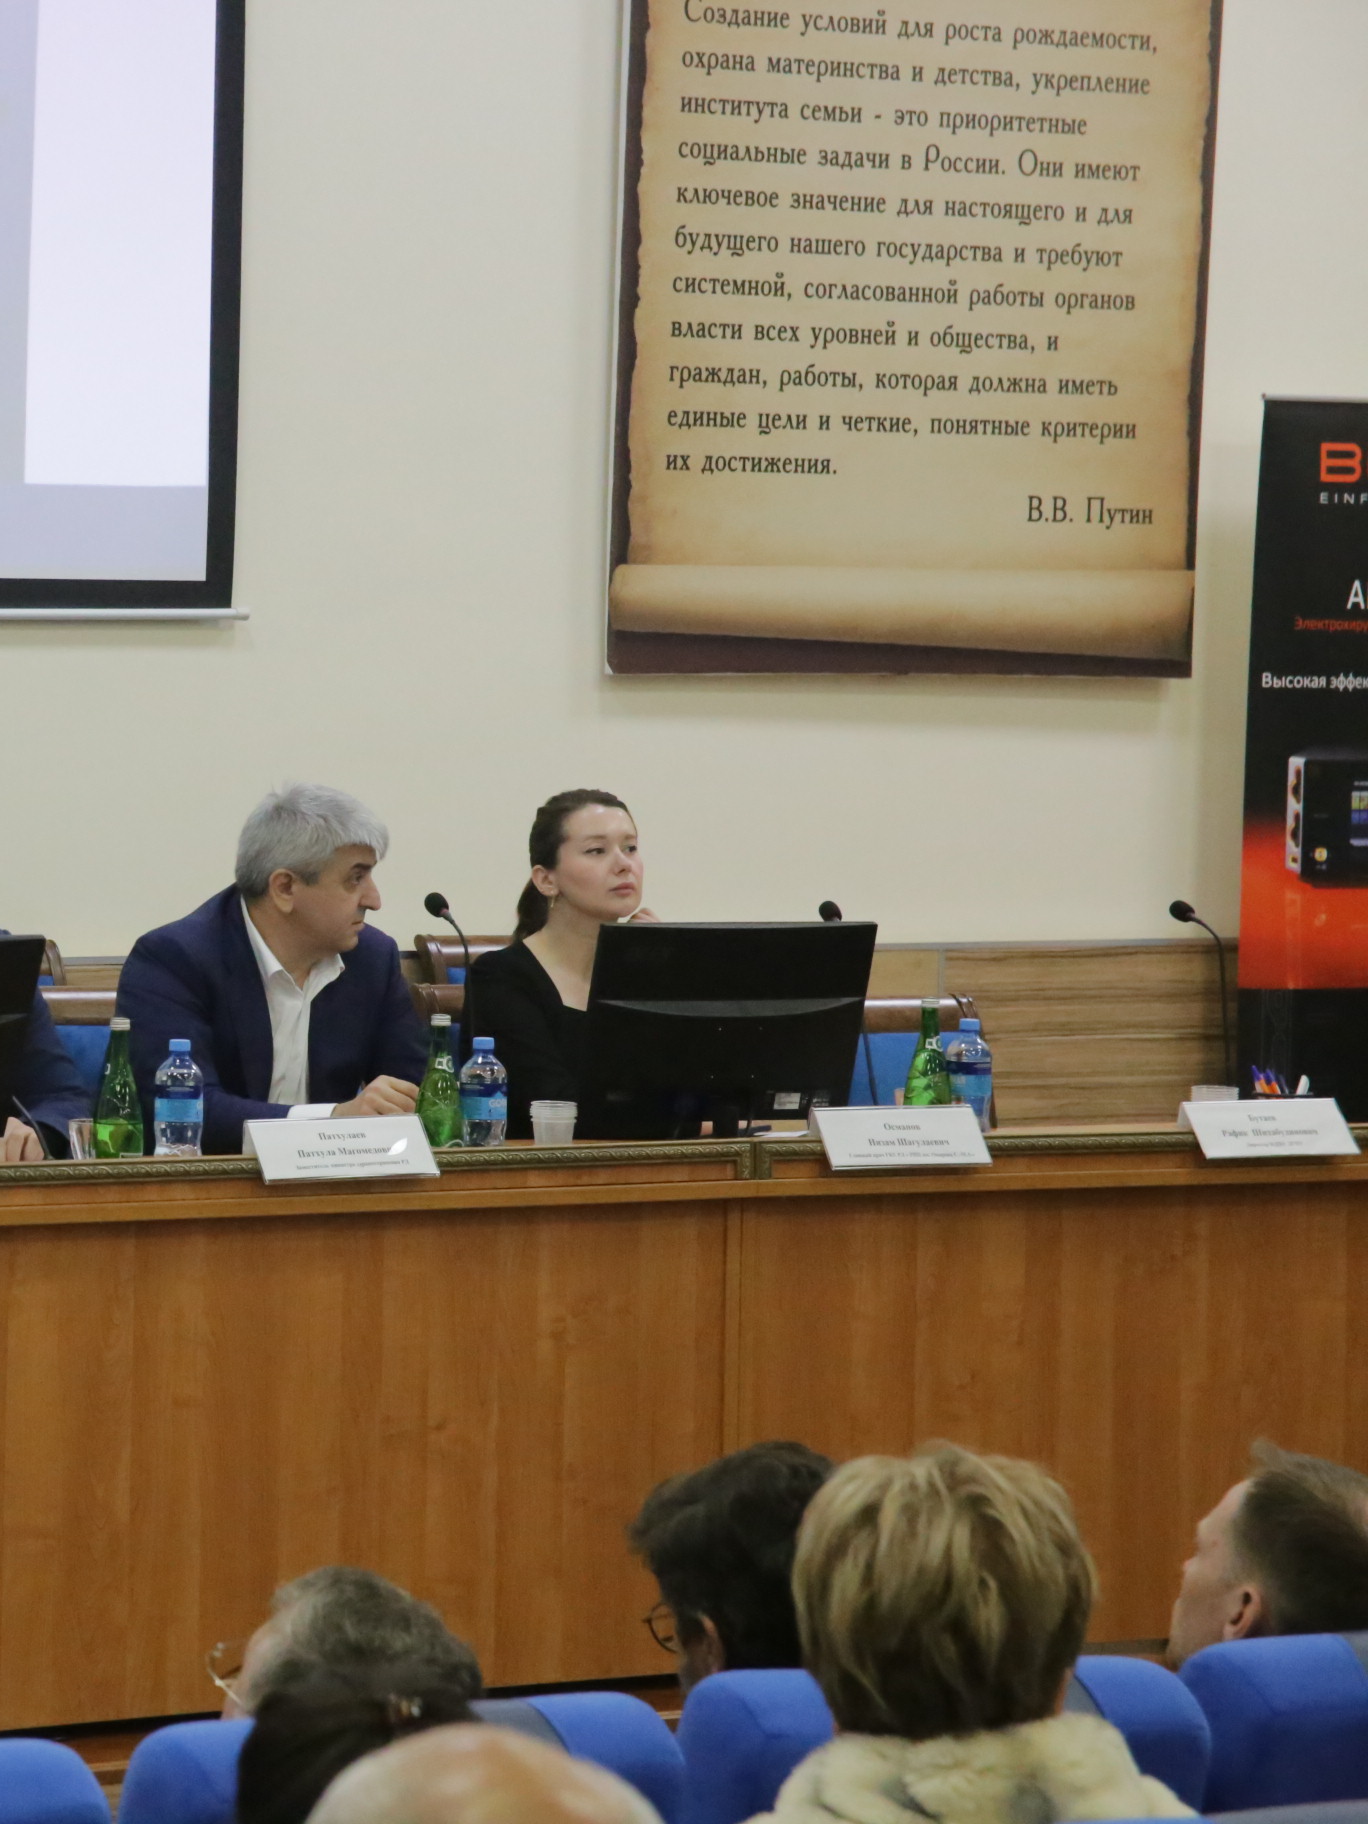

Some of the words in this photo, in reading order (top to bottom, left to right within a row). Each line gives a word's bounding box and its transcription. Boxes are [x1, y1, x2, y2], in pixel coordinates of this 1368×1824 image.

[684, 0, 789, 28] Создание
[800, 10, 886, 36] условий
[897, 20, 934, 40] для
[945, 23, 1002, 46] роста
[1013, 27, 1157, 54] рождаемости,
[682, 51, 755, 76] охрана
[767, 57, 900, 83] материнства
[912, 66, 923, 82] и
[934, 67, 1020, 91] детства,
[1031, 73, 1150, 96] укрепление
[681, 96, 789, 124] института
[800, 104, 862, 123] семьи
[894, 109, 928, 126] это
[939, 112, 1087, 137] приоритетные
[679, 142, 806, 166] социальные
[818, 150, 890, 170] задачи
[901, 154, 911, 170] в
[924, 144, 1005, 175] России.
[1018, 149, 1063, 177] Они
[1074, 163, 1140, 181] имеют
[676, 187, 779, 208] ключевое
[790, 193, 886, 213] значение
[897, 198, 933, 217] для
[944, 201, 1064, 226] настоящего
[1075, 207, 1087, 222] и
[1097, 208, 1133, 226] для
[675, 225, 778, 257] будущего
[790, 237, 865, 256] нашего
[877, 242, 1003, 266] государства
[1014, 248, 1025, 263] и
[1036, 243, 1123, 272] требуют
[673, 272, 791, 301] системной,
[804, 280, 958, 304] согласованной
[969, 283, 1044, 311] работы
[1055, 293, 1135, 315] органов
[671, 321, 743, 340] власти
[754, 325, 800, 342] всех
[810, 321, 896, 349] уровней
[907, 331, 919, 346] и
[930, 325, 1035, 354] общества,
[1047, 336, 1059, 351] и
[669, 366, 767, 389] граждан,
[779, 364, 863, 392] работы,
[875, 373, 958, 397] которая
[969, 376, 1047, 394] должна
[1058, 379, 1118, 396] иметь
[667, 410, 746, 429] единые
[758, 413, 807, 435] цели
[819, 415, 830, 431] и
[842, 416, 918, 437] четкие,
[930, 418, 1030, 436] понятные
[1041, 421, 1136, 445] критерии
[666, 455, 690, 471] их
[701, 455, 837, 475] достижения.
[1320, 442, 1368, 483] B
[1027, 495, 1073, 523] В.В.
[1086, 497, 1153, 530] Путин
[1261, 672, 1327, 689] Высокая
[297, 1148, 336, 1160] Патхула
[318, 1132, 366, 1142] Патхулаев
